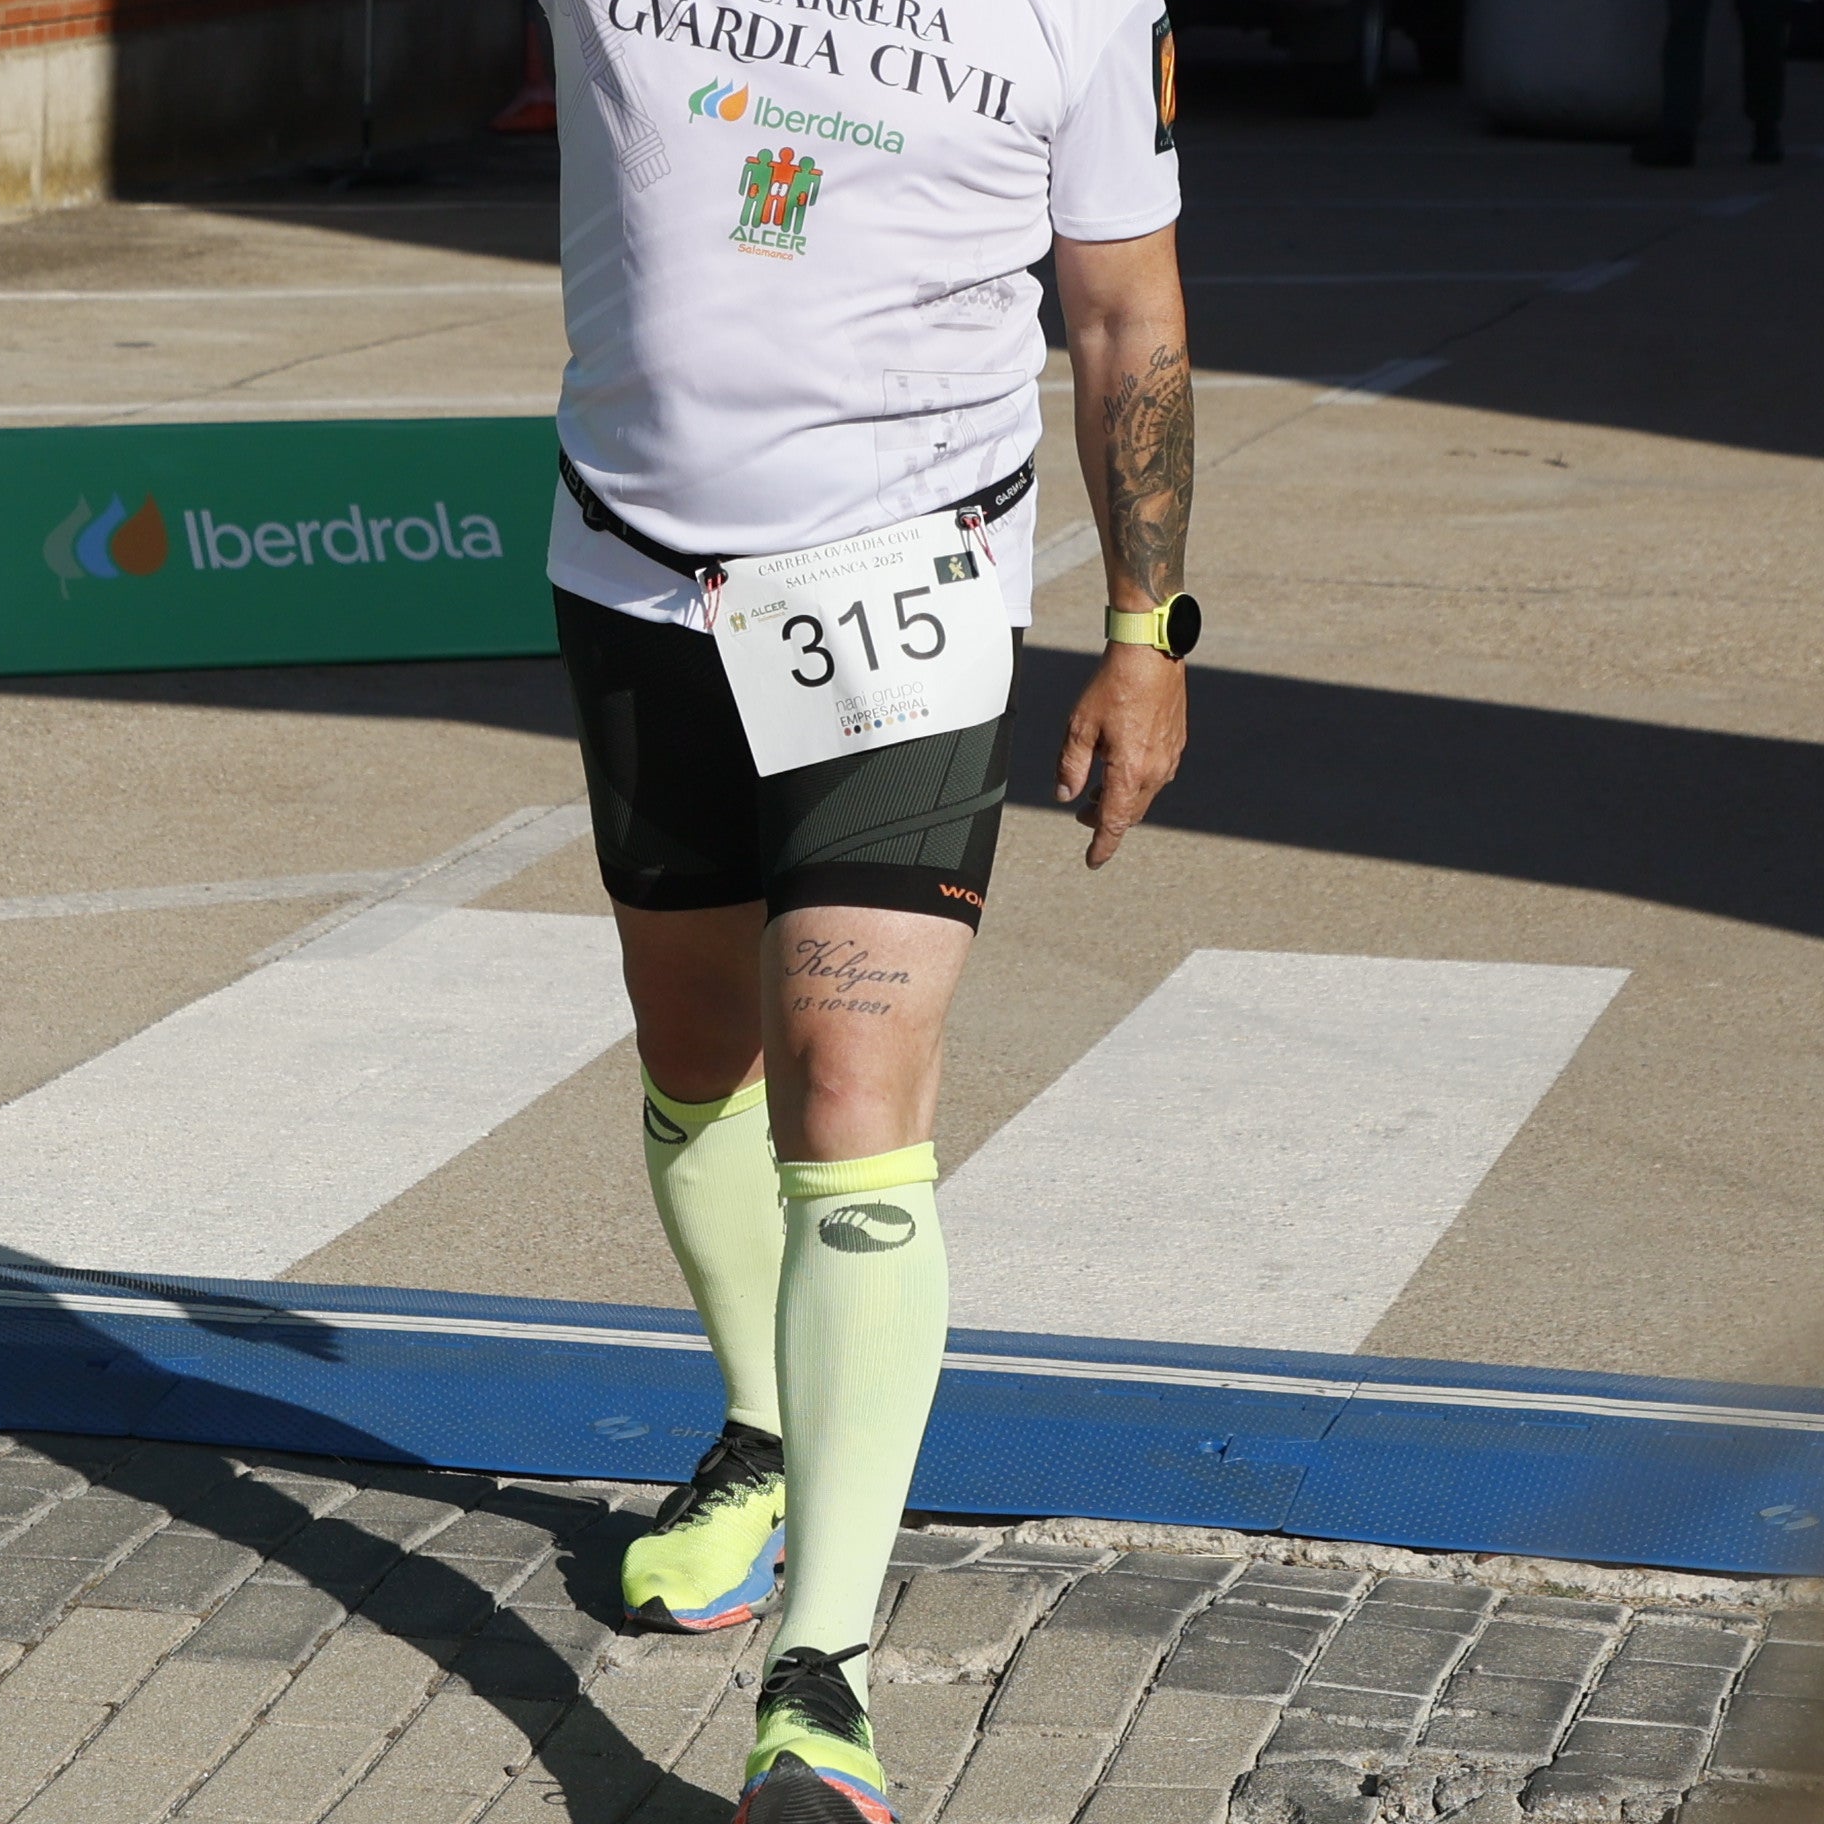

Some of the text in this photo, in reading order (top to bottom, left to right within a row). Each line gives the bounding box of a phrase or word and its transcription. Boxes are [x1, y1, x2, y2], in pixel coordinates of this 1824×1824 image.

[870, 43, 1017, 126] CIVIL
[753, 96, 905, 155] Iberdrola
[728, 225, 806, 256] ALCER
[737, 243, 794, 261] Salamanca
[995, 473, 1028, 506] GARMIN
[183, 501, 503, 570] Iberdrola
[758, 551, 822, 577] CARRERA
[824, 536, 886, 559] GVARDIA
[785, 551, 904, 590] SALAMANCA 2025
[751, 600, 788, 618] ALCER
[781, 586, 946, 688] 315
[835, 681, 924, 713] nani grupo
[839, 697, 929, 728] EMPRESARIAL
[784, 939, 911, 993] Kelyan
